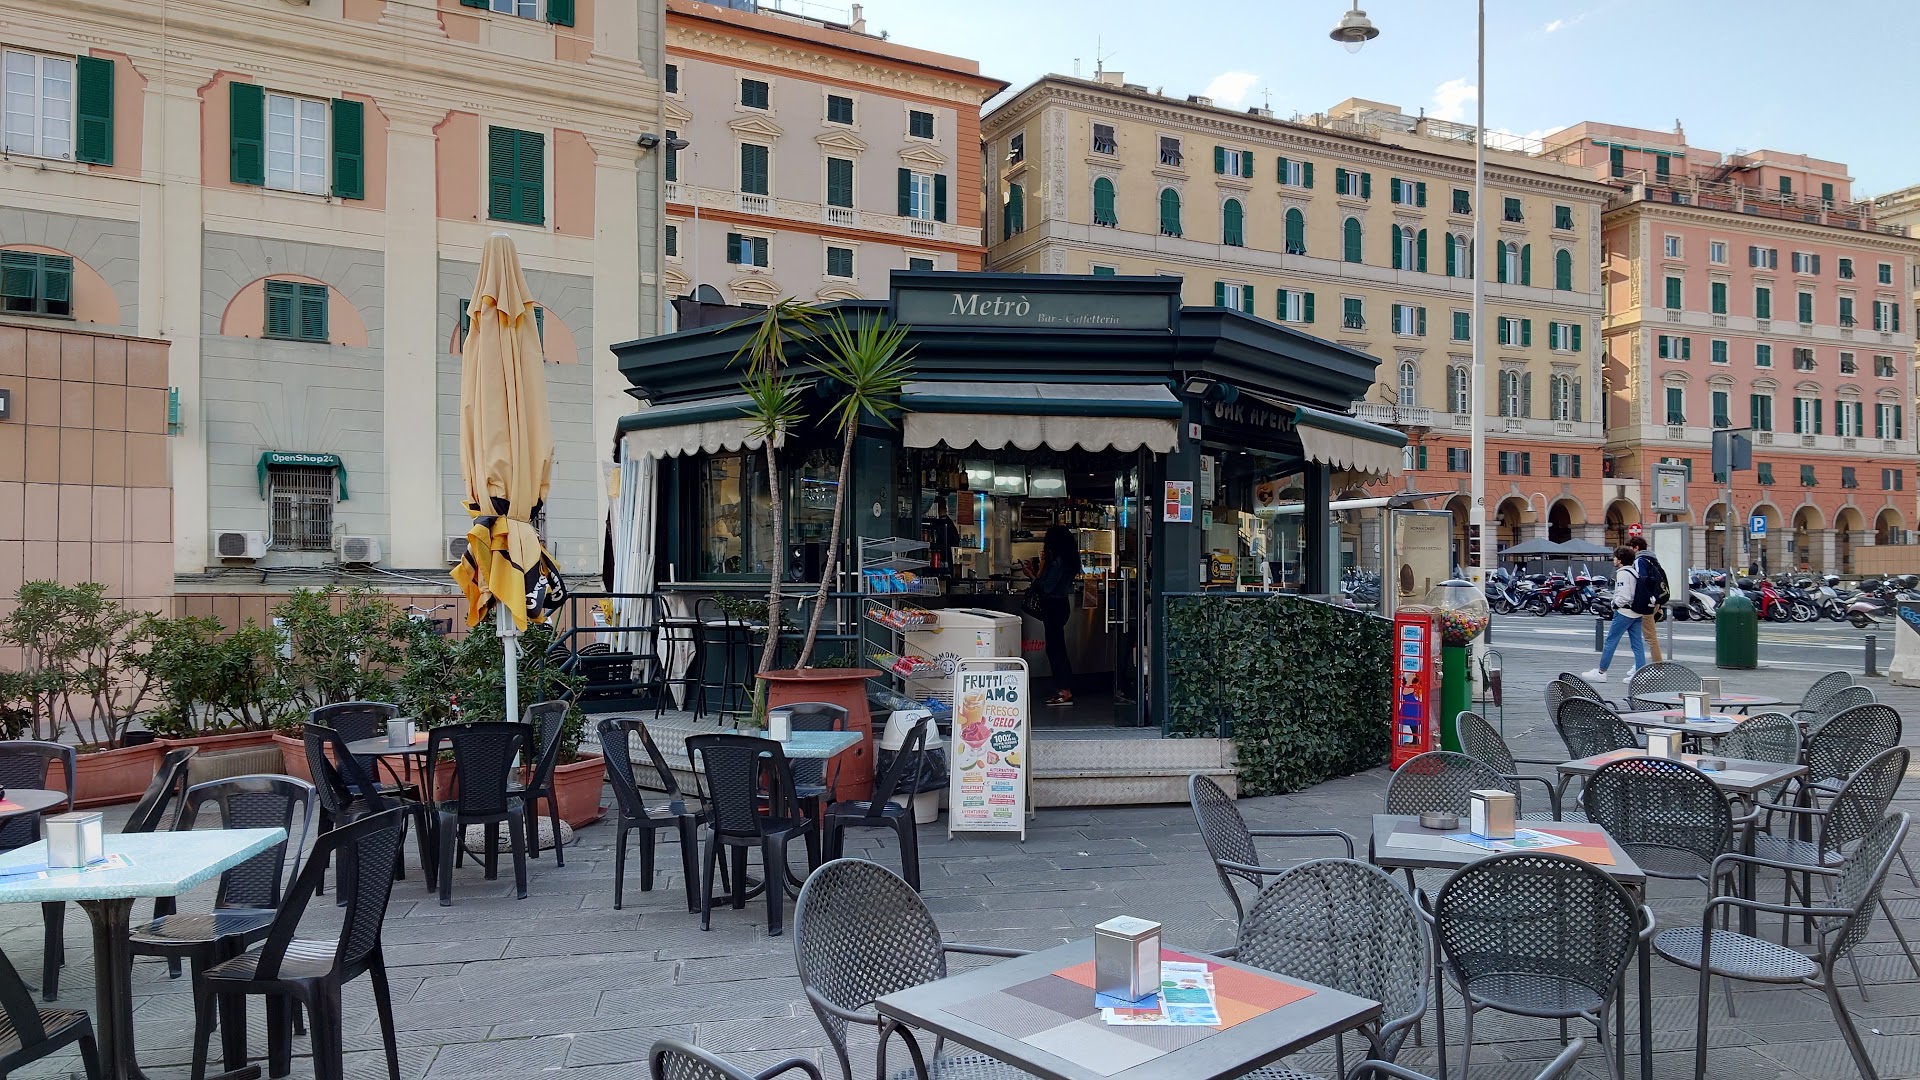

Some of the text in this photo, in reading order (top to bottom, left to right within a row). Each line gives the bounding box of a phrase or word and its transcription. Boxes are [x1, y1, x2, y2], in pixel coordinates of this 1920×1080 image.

[950, 293, 1030, 317] Metrò
[1037, 313, 1056, 323] Bar
[272, 453, 334, 463] OpenShop24
[1753, 517, 1764, 531] P
[962, 674, 1002, 693] FRUTTI
[985, 704, 1020, 717] FRESCO
[993, 718, 1015, 728] GELO
[994, 733, 1012, 743] 100%
